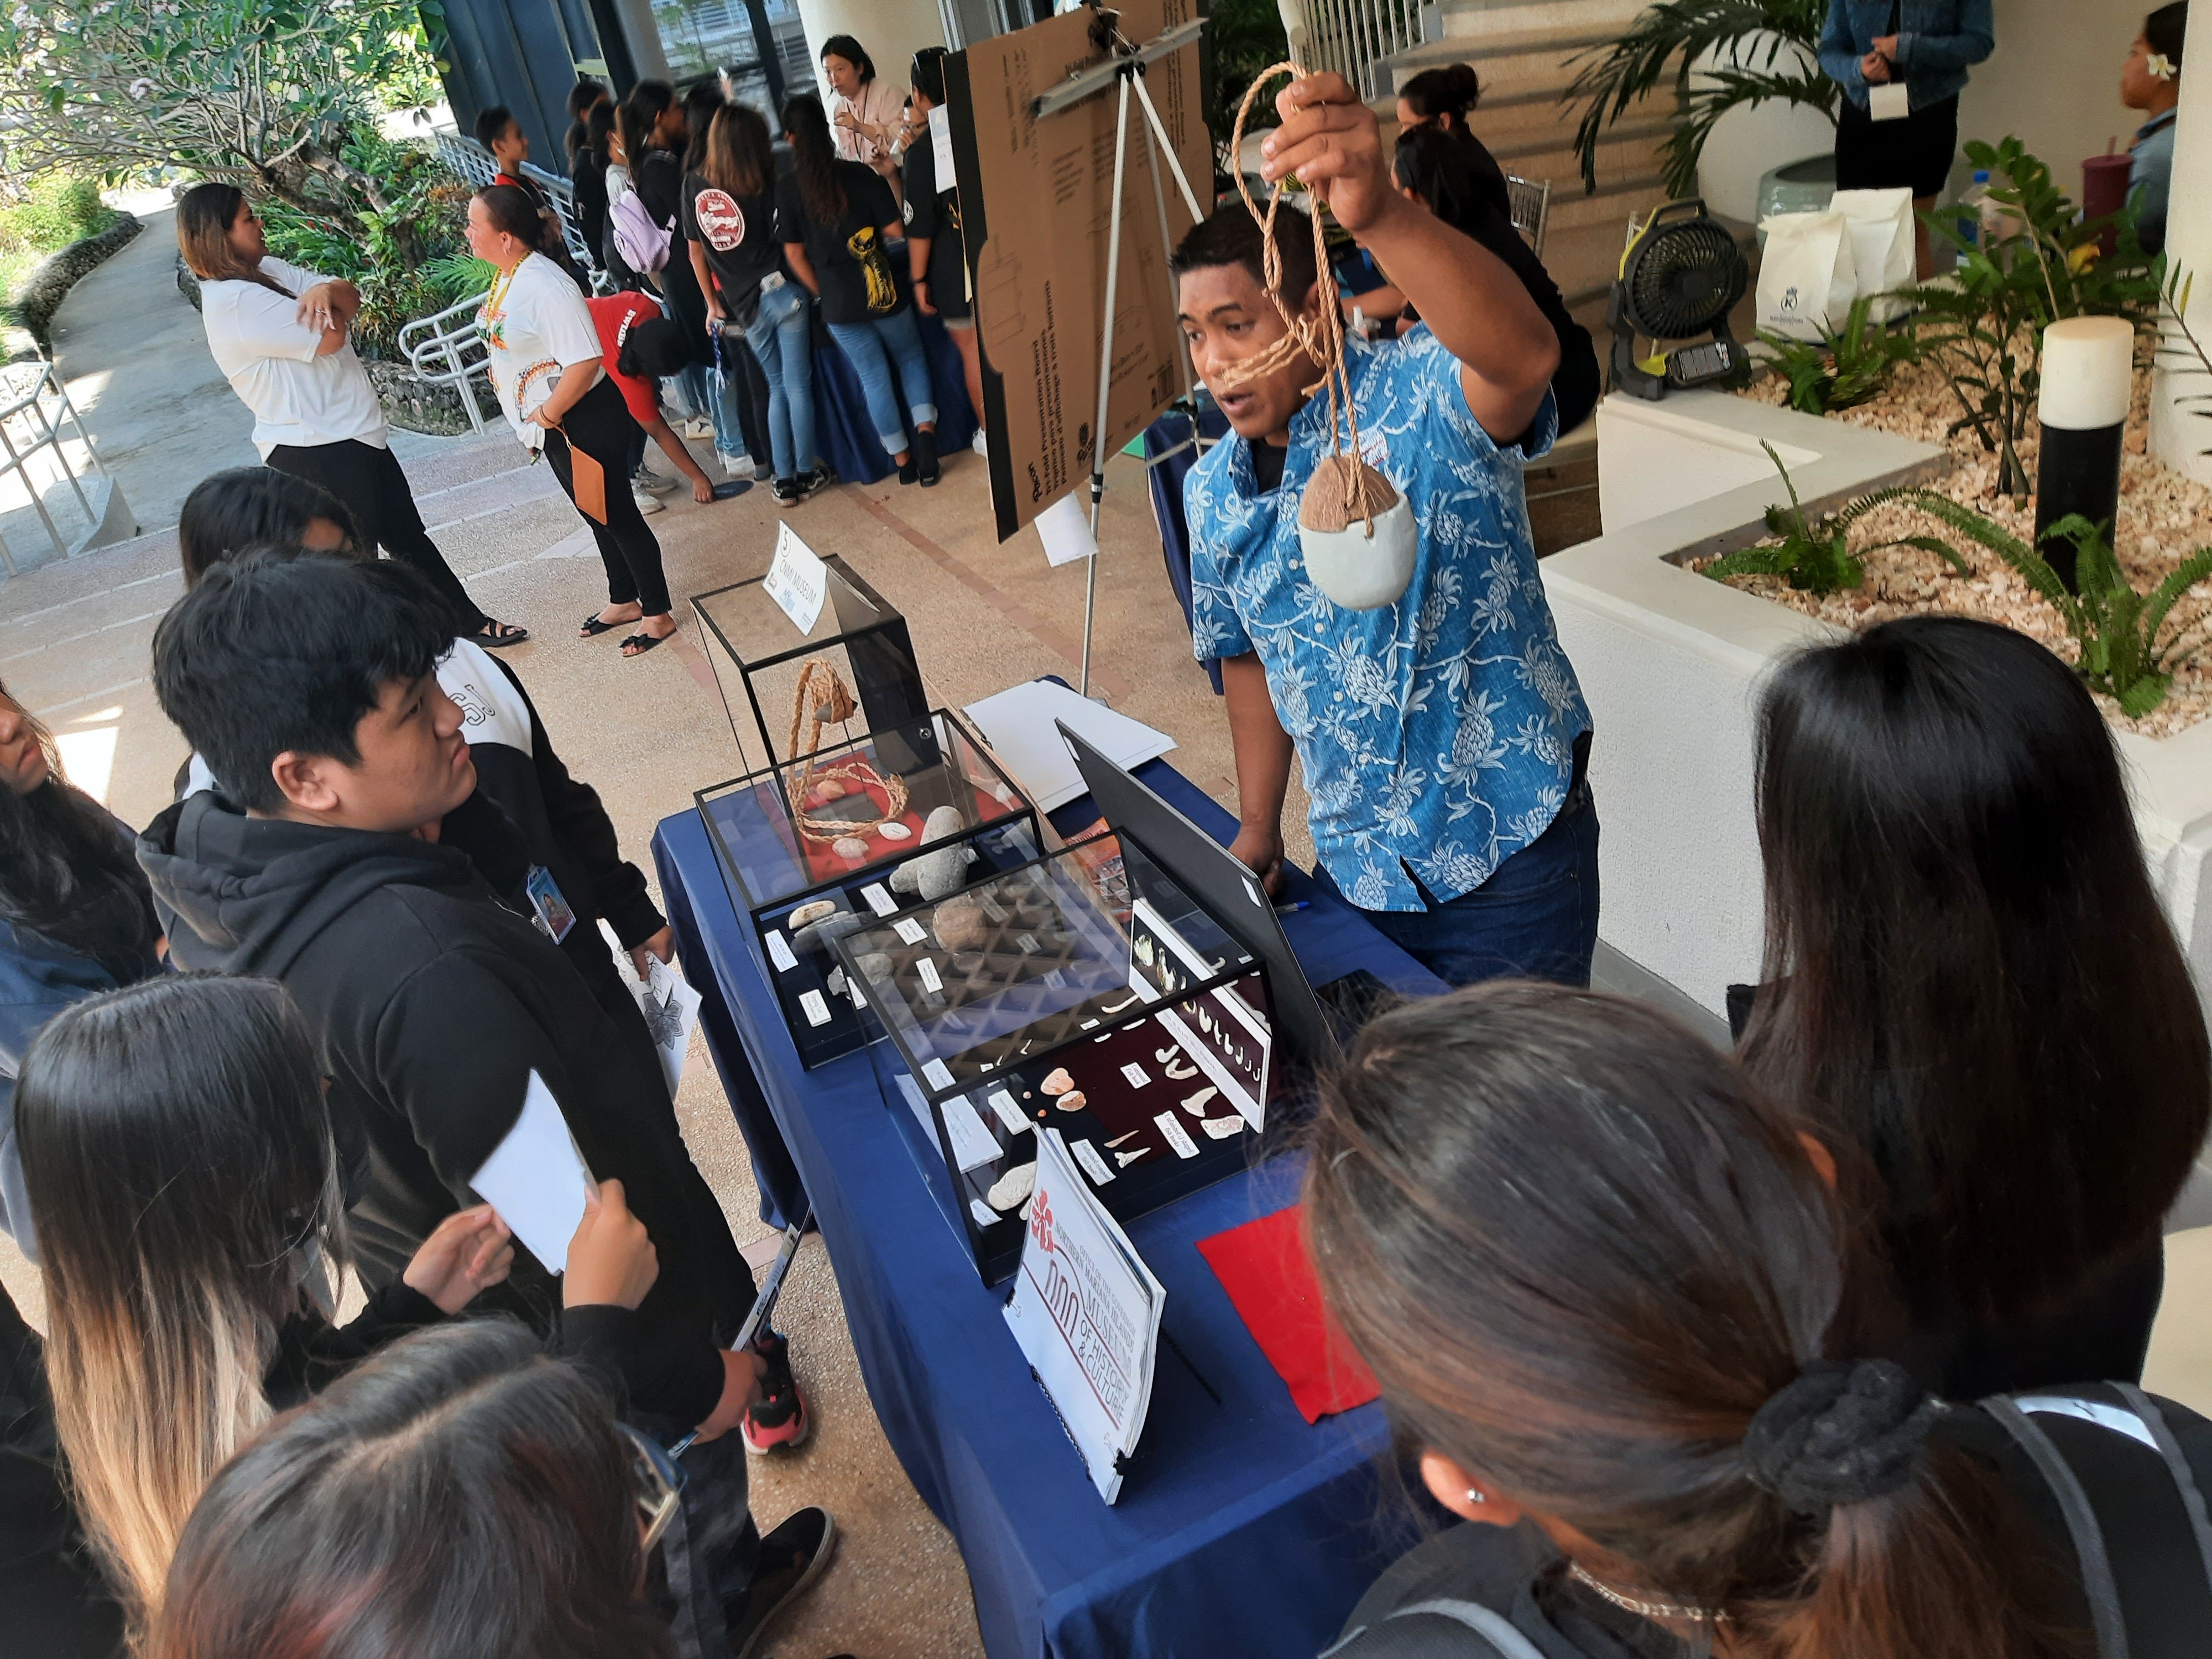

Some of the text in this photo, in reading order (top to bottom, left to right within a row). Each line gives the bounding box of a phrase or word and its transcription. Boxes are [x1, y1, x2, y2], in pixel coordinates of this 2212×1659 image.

[1045, 280, 1054, 330] battants
[1041, 329, 1055, 416] presentaciones
[1032, 340, 1052, 494] Tri-Fold Presentation Board
[1048, 420, 1057, 445] para
[780, 559, 795, 585] CNMI
[792, 571, 817, 606] MUSEUM
[783, 530, 788, 551] 5
[1054, 1219, 1134, 1354] NORTHERN MARIANA ISLANDS
[1078, 1243, 1136, 1339] OFFICE OF THE GOVERNOR
[1081, 1320, 1130, 1405] OF HISTORY
[1086, 1288, 1132, 1377] MUSEUM
[1078, 1342, 1124, 1426] & CULTURE
